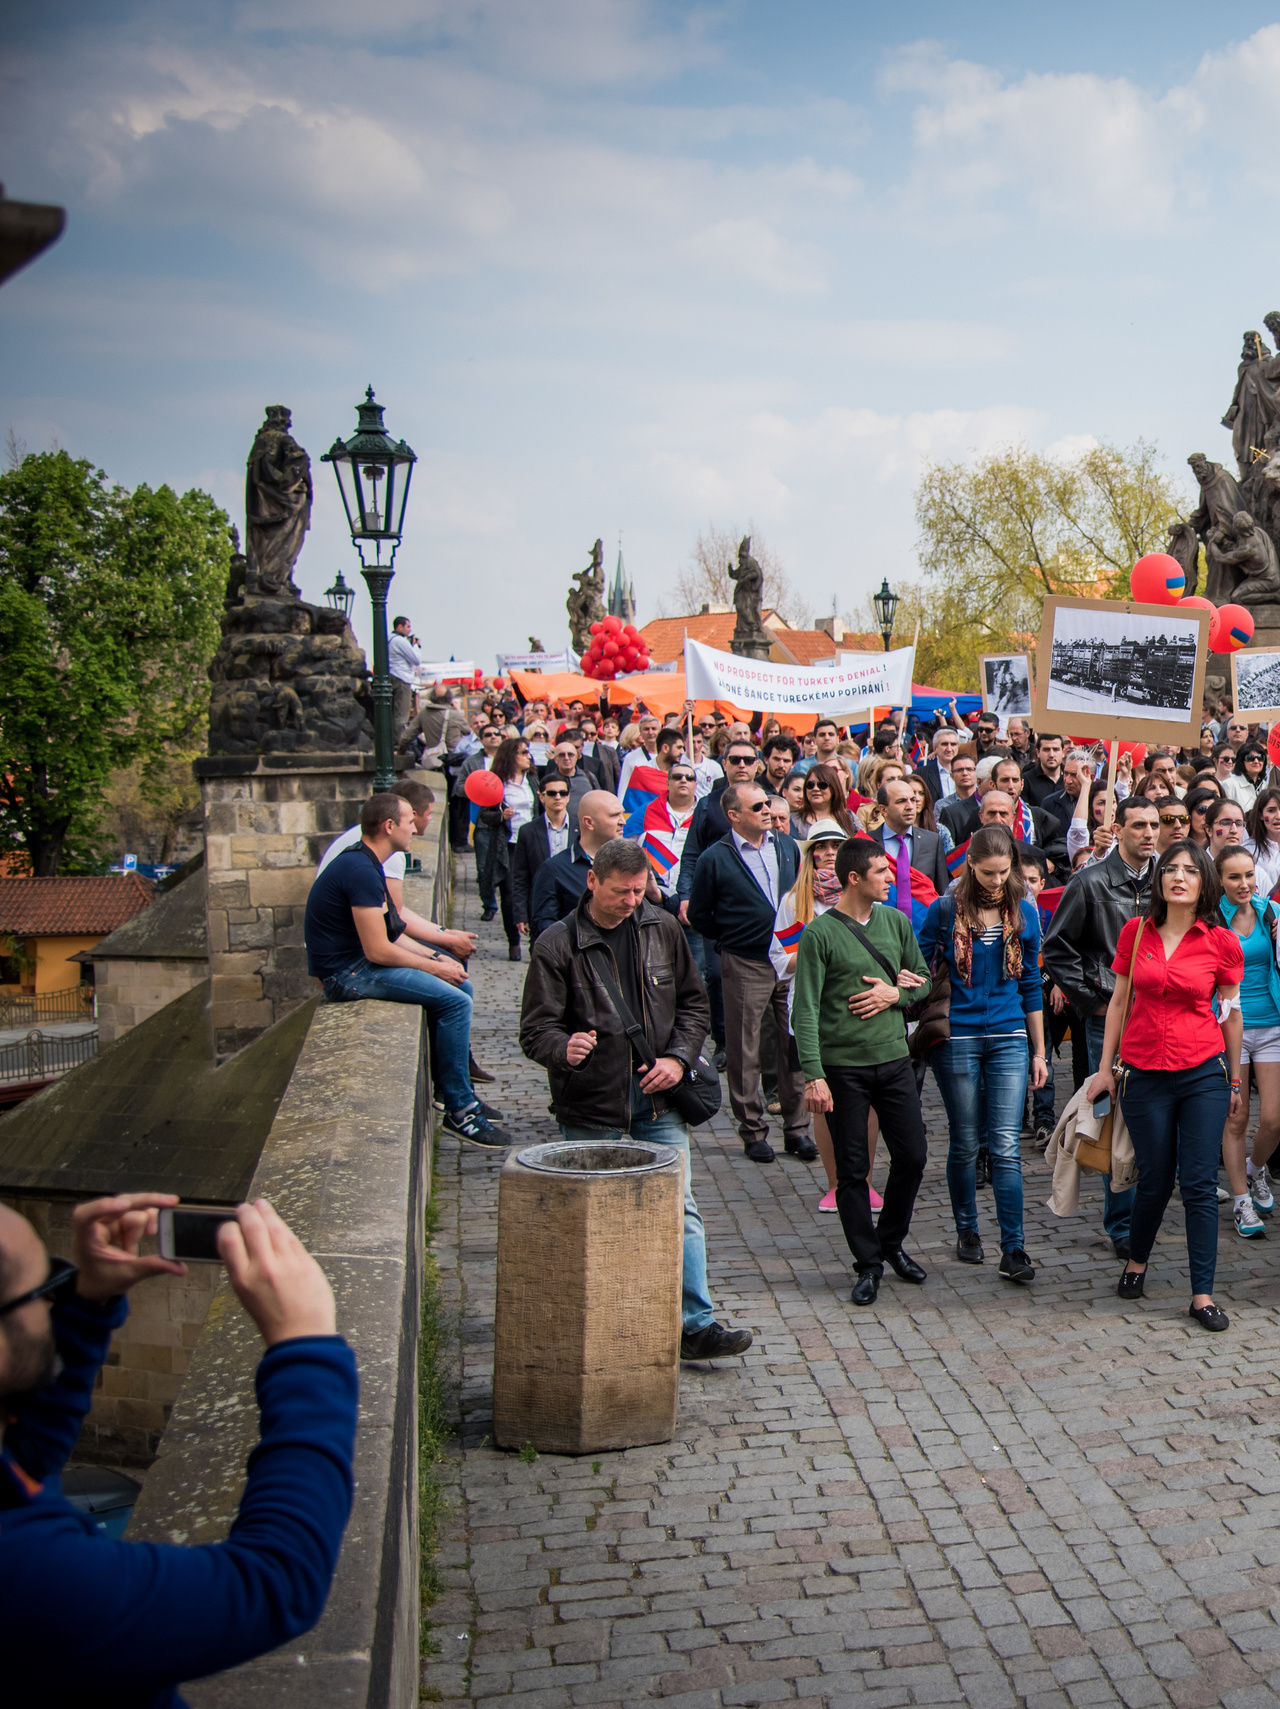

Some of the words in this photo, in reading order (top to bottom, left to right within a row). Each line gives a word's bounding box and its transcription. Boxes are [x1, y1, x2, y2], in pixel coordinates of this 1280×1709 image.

[714, 660, 725, 672] NO
[727, 665, 773, 684] PROSPECT
[777, 675, 795, 686] FOR
[798, 675, 844, 686] TURKEY'S
[847, 667, 881, 681] DENIAL
[744, 686, 775, 702] ŠANCE
[777, 690, 835, 703] TURECKÉMU
[838, 680, 884, 696] POPÍRÁNÍ
